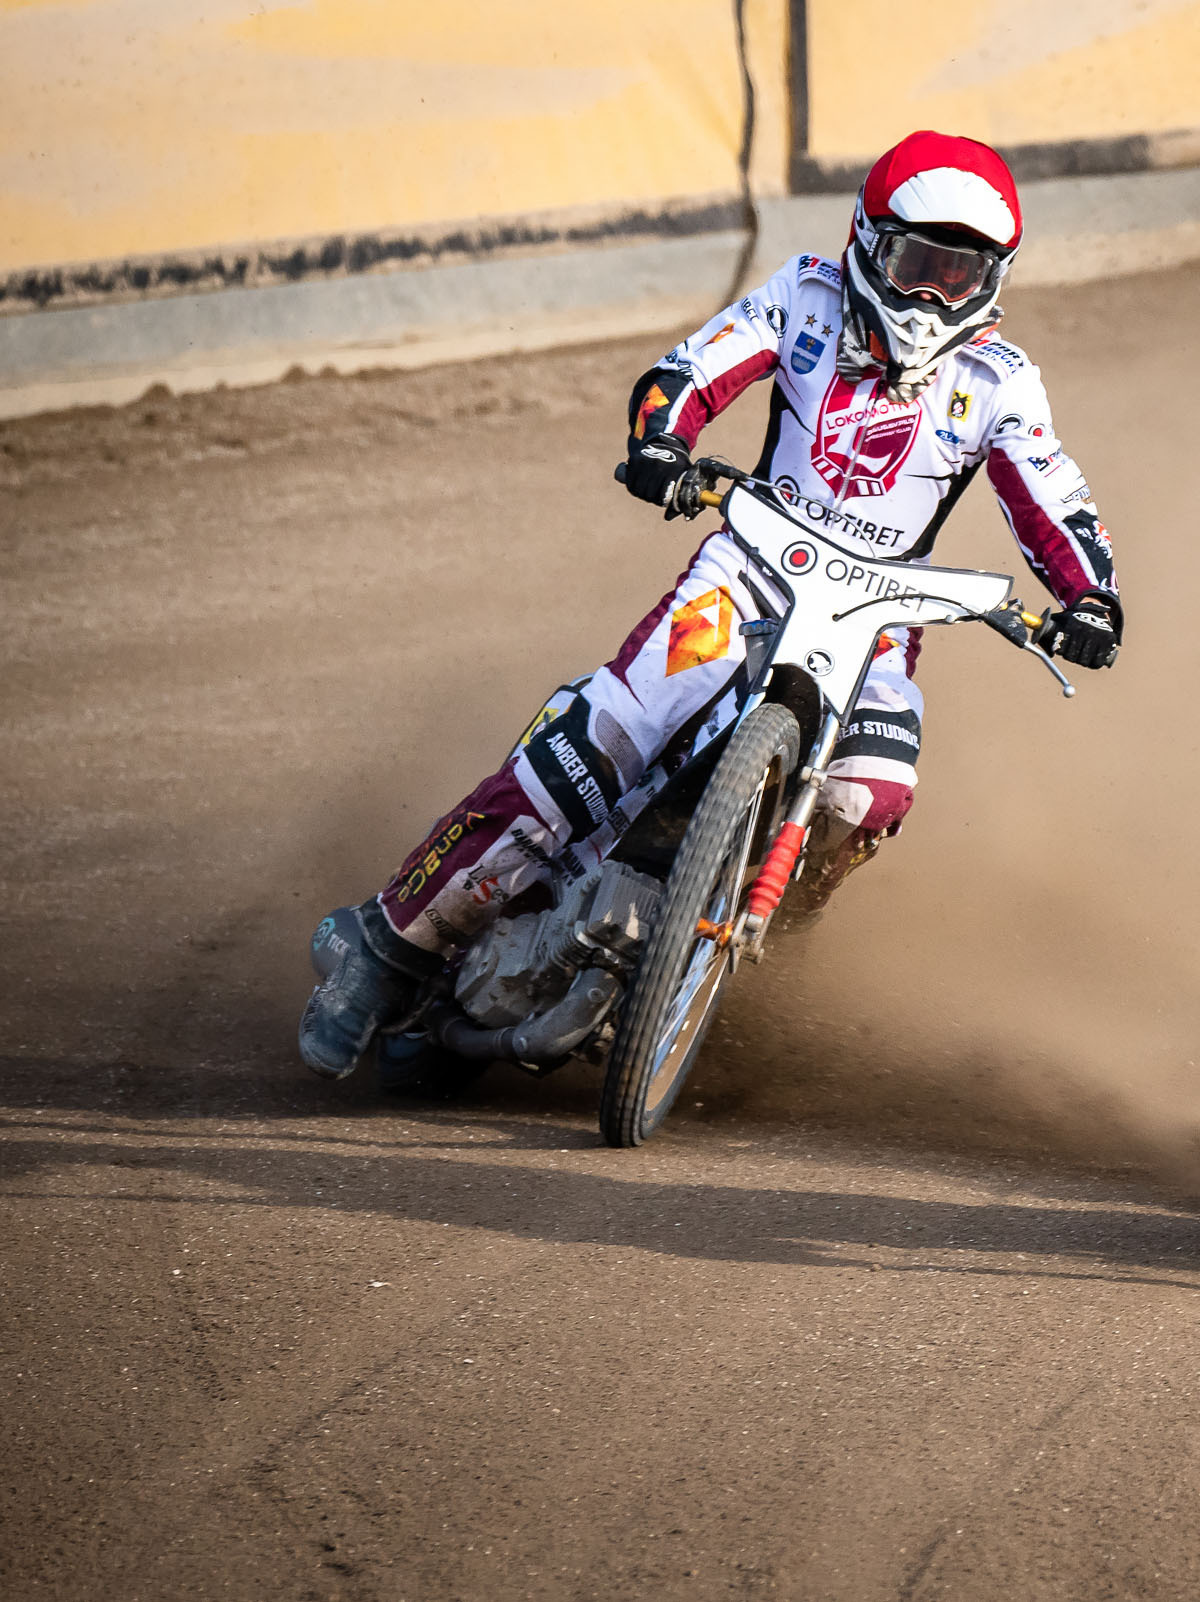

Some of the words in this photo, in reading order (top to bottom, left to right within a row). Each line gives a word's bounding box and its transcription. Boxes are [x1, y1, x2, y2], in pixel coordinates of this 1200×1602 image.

[805, 500, 905, 548] OPTIBET
[825, 559, 929, 612] OPTIBET
[546, 731, 589, 783] AMBER
